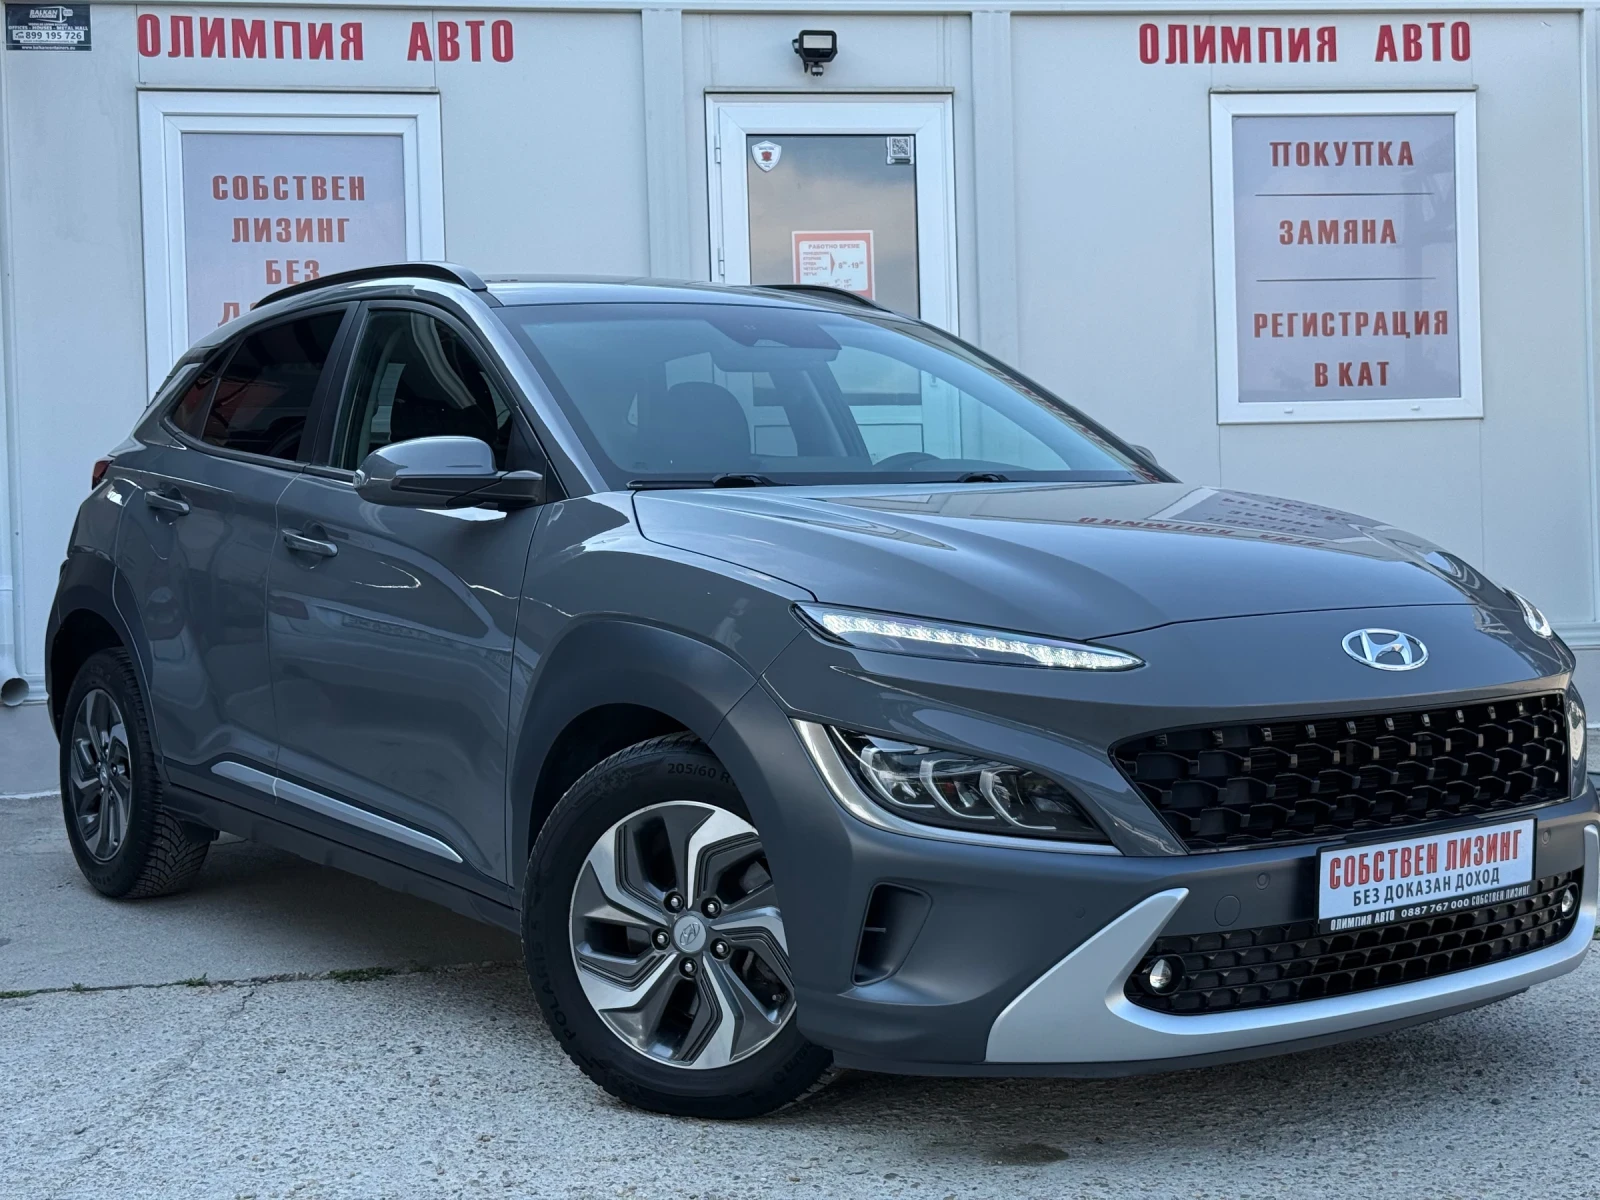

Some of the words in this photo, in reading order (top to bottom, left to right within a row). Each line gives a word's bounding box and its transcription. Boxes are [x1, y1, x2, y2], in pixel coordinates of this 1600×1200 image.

[138, 14, 363, 61] ОЛИМПИЯ
[407, 20, 514, 62] АВТО
[1139, 23, 1337, 64] ОЛИМПИЯ
[1375, 21, 1471, 63] АВТО
[1270, 140, 1414, 167] ПОКУПКА
[212, 175, 366, 201] СОБСТВЕН
[232, 217, 350, 243] ЛИЗИНГ
[1279, 219, 1396, 245] ЗАМЯНА
[266, 260, 320, 284] БЕЗ
[1254, 310, 1448, 338] РЕГИСТРАЦИЯ
[1314, 362, 1328, 388] В
[1338, 361, 1390, 387] КАТ
[667, 762, 716, 779] 205/60
[1329, 842, 1438, 890] СОБСТВЕН
[1445, 829, 1522, 872] ЛИЗИНГ
[1354, 887, 1380, 906] БЕЗ
[1384, 875, 1451, 905] ДОКАЗАН
[1455, 867, 1500, 892] ДОХОД
[1330, 916, 1372, 931] ОЛИМПИЯ
[1374, 910, 1395, 924] АВТО
[1401, 906, 1427, 918] 0887
[1430, 902, 1448, 913] 767
[1451, 898, 1469, 909] 000
